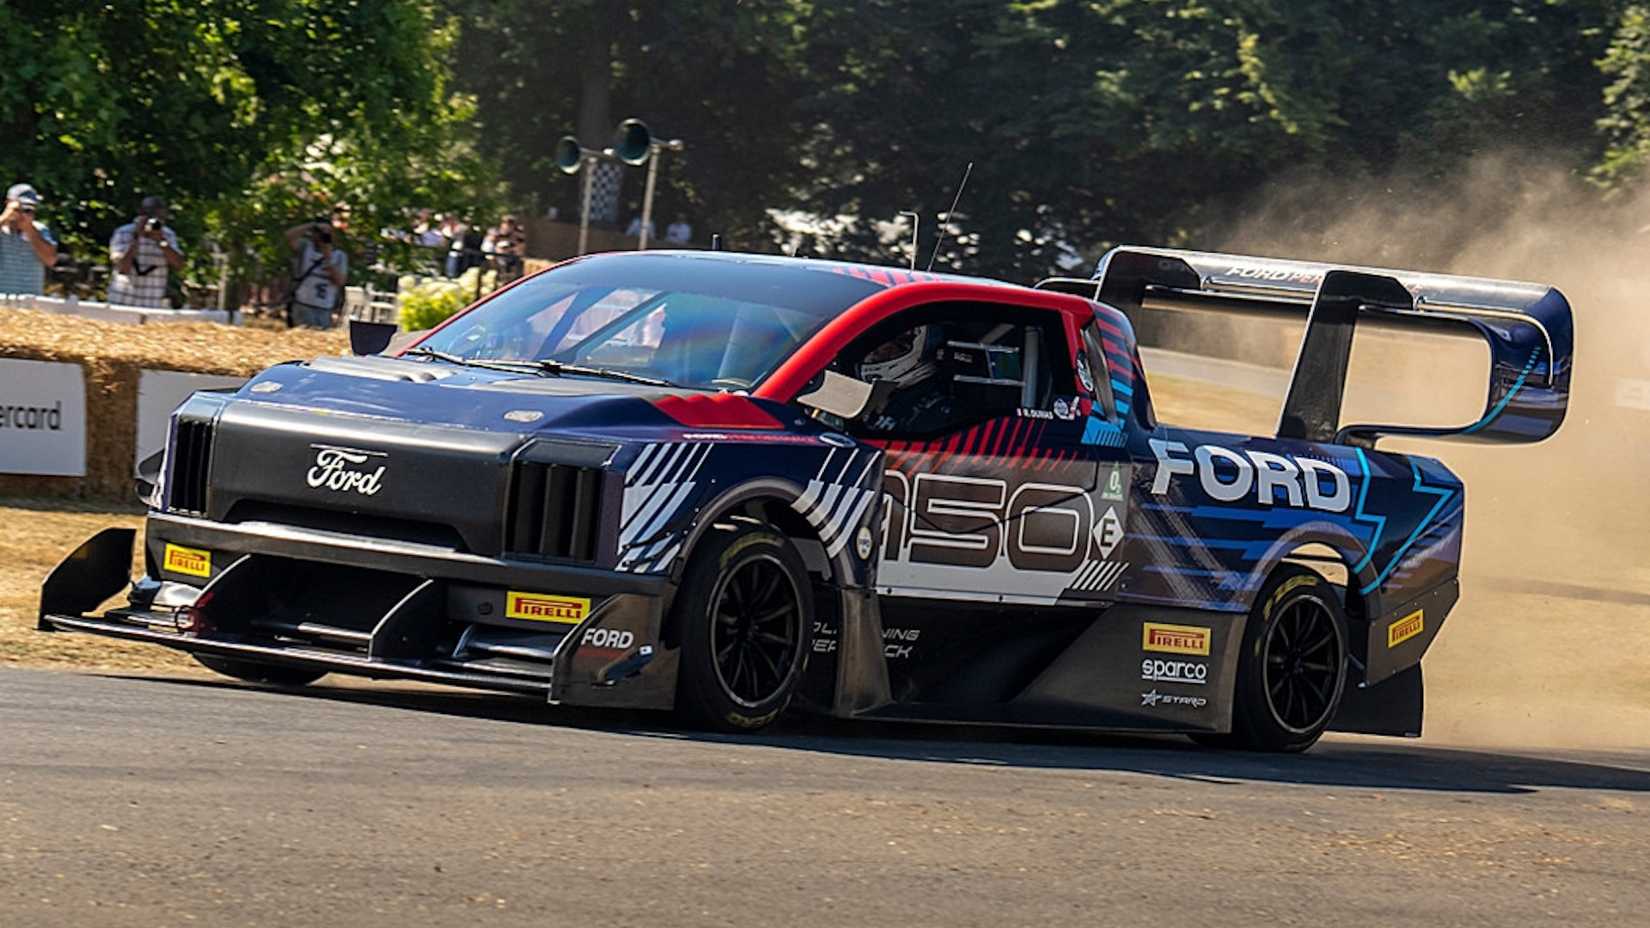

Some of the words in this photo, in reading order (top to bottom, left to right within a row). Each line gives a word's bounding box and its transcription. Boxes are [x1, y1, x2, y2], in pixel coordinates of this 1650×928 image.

[306, 449, 386, 495] Ford
[1149, 438, 1351, 513] FORD
[1101, 518, 1116, 547] E
[514, 597, 583, 619] PIRELLI
[581, 628, 635, 648] FORD
[1149, 628, 1205, 649] PIRELLI
[1142, 659, 1207, 681] sparco
